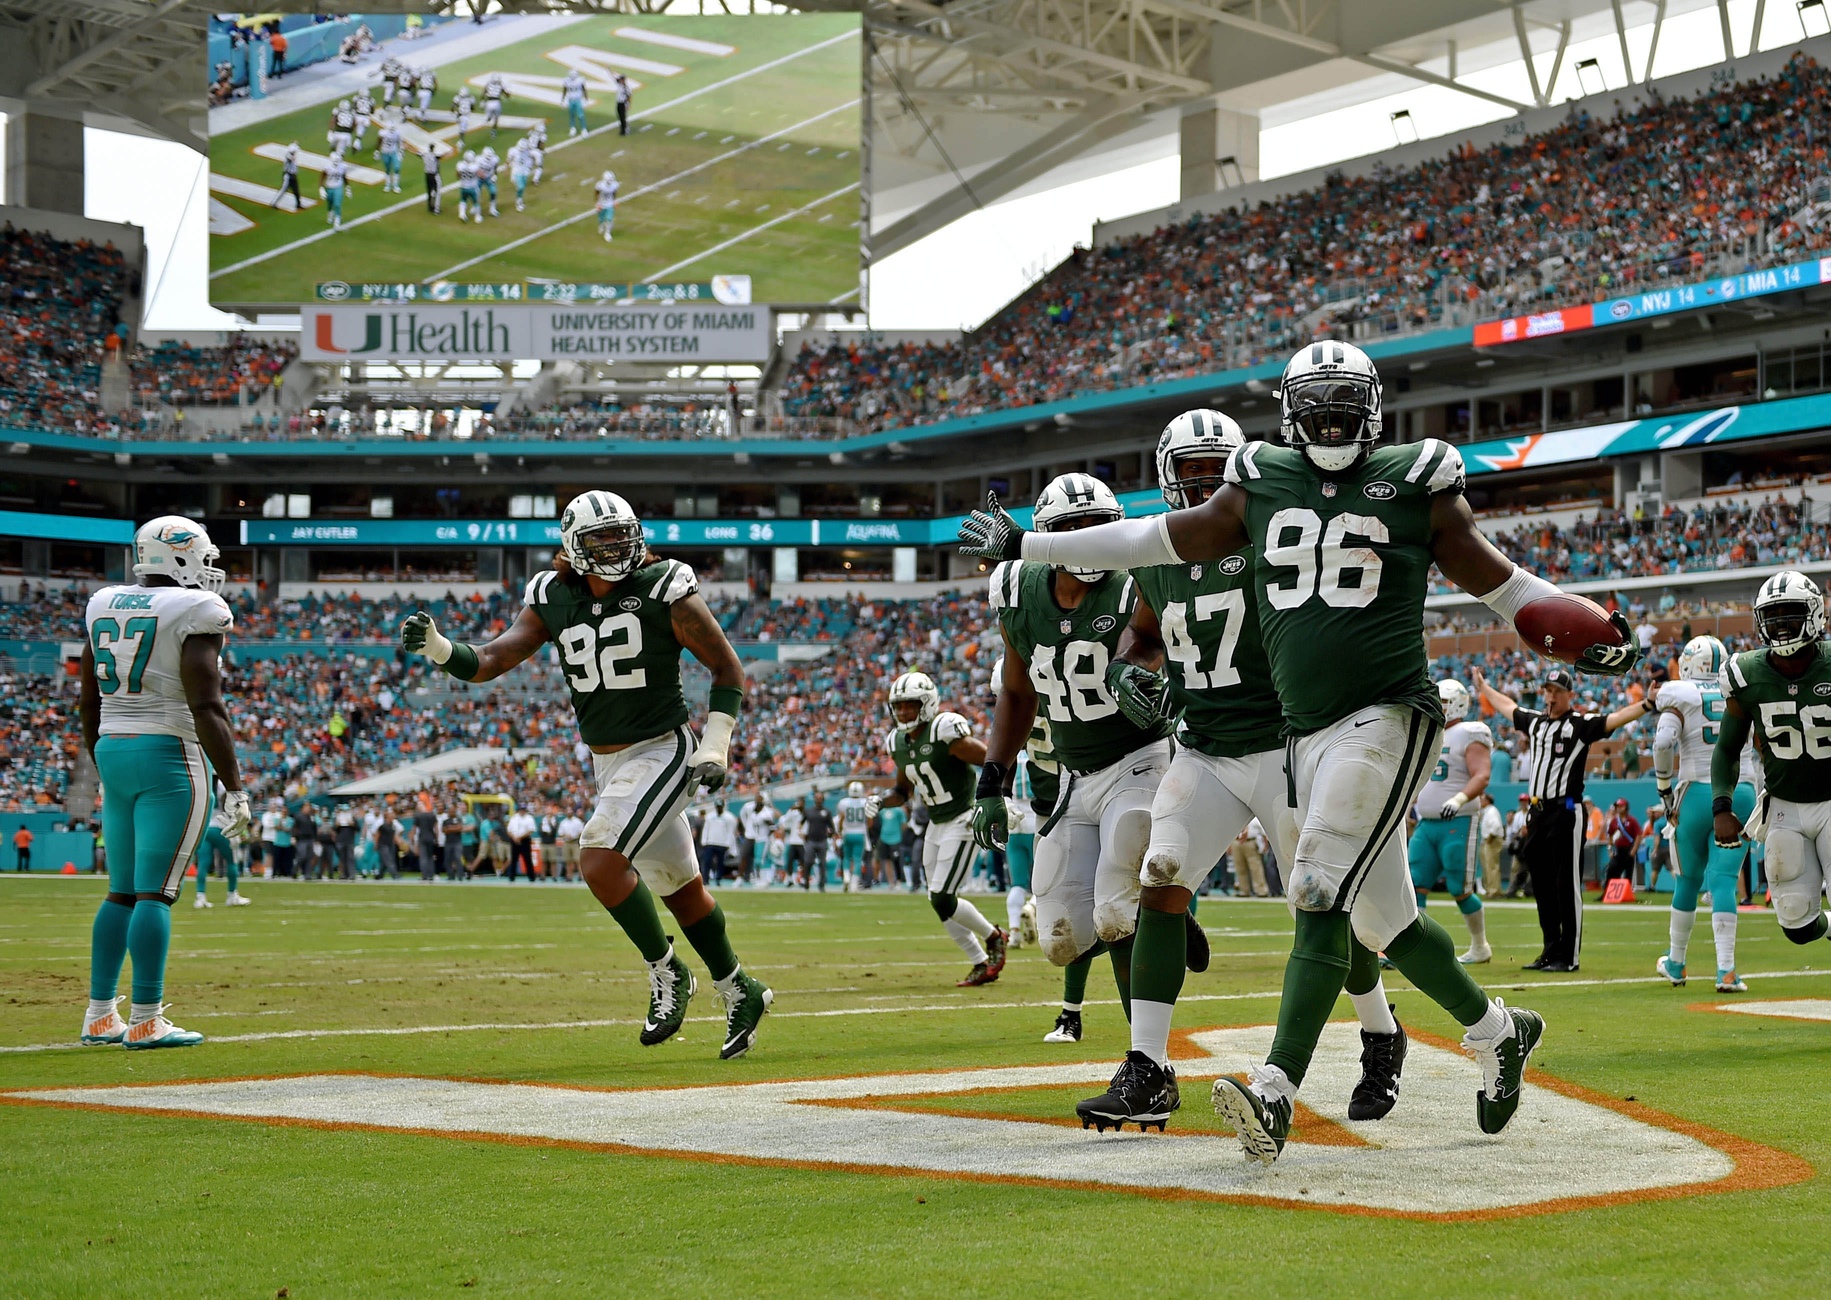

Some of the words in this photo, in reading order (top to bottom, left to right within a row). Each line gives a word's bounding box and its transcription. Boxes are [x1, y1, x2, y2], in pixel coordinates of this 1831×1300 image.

[362, 283, 390, 297] NYJ
[395, 283, 417, 299] 14
[467, 283, 495, 297] MIA
[500, 283, 522, 299] 14
[1642, 291, 1671, 313] NYJ
[1678, 286, 1695, 305] 14
[1747, 270, 1777, 293] MIA
[1782, 265, 1800, 285] 14
[552, 312, 659, 330] UNIVERSITY
[664, 312, 687, 330] OF
[693, 312, 755, 330] MIAMI
[552, 336, 621, 353] HEALTH
[626, 336, 699, 353] SYSTEM
[291, 526, 315, 540] JAY
[315, 526, 359, 540] CUTLER
[467, 522, 518, 541] 9/11
[667, 523, 680, 541] 2
[705, 526, 738, 540] LONG
[749, 523, 774, 541] 36
[1264, 507, 1390, 611] 96
[91, 616, 158, 695] 67
[558, 612, 646, 693] 92
[1161, 588, 1246, 689] 47
[1029, 640, 1119, 722] 48
[1758, 701, 1831, 760] 56
[1606, 882, 1625, 900] 20
[88, 1013, 114, 1036] NIKE
[128, 1018, 157, 1042] NIKE
